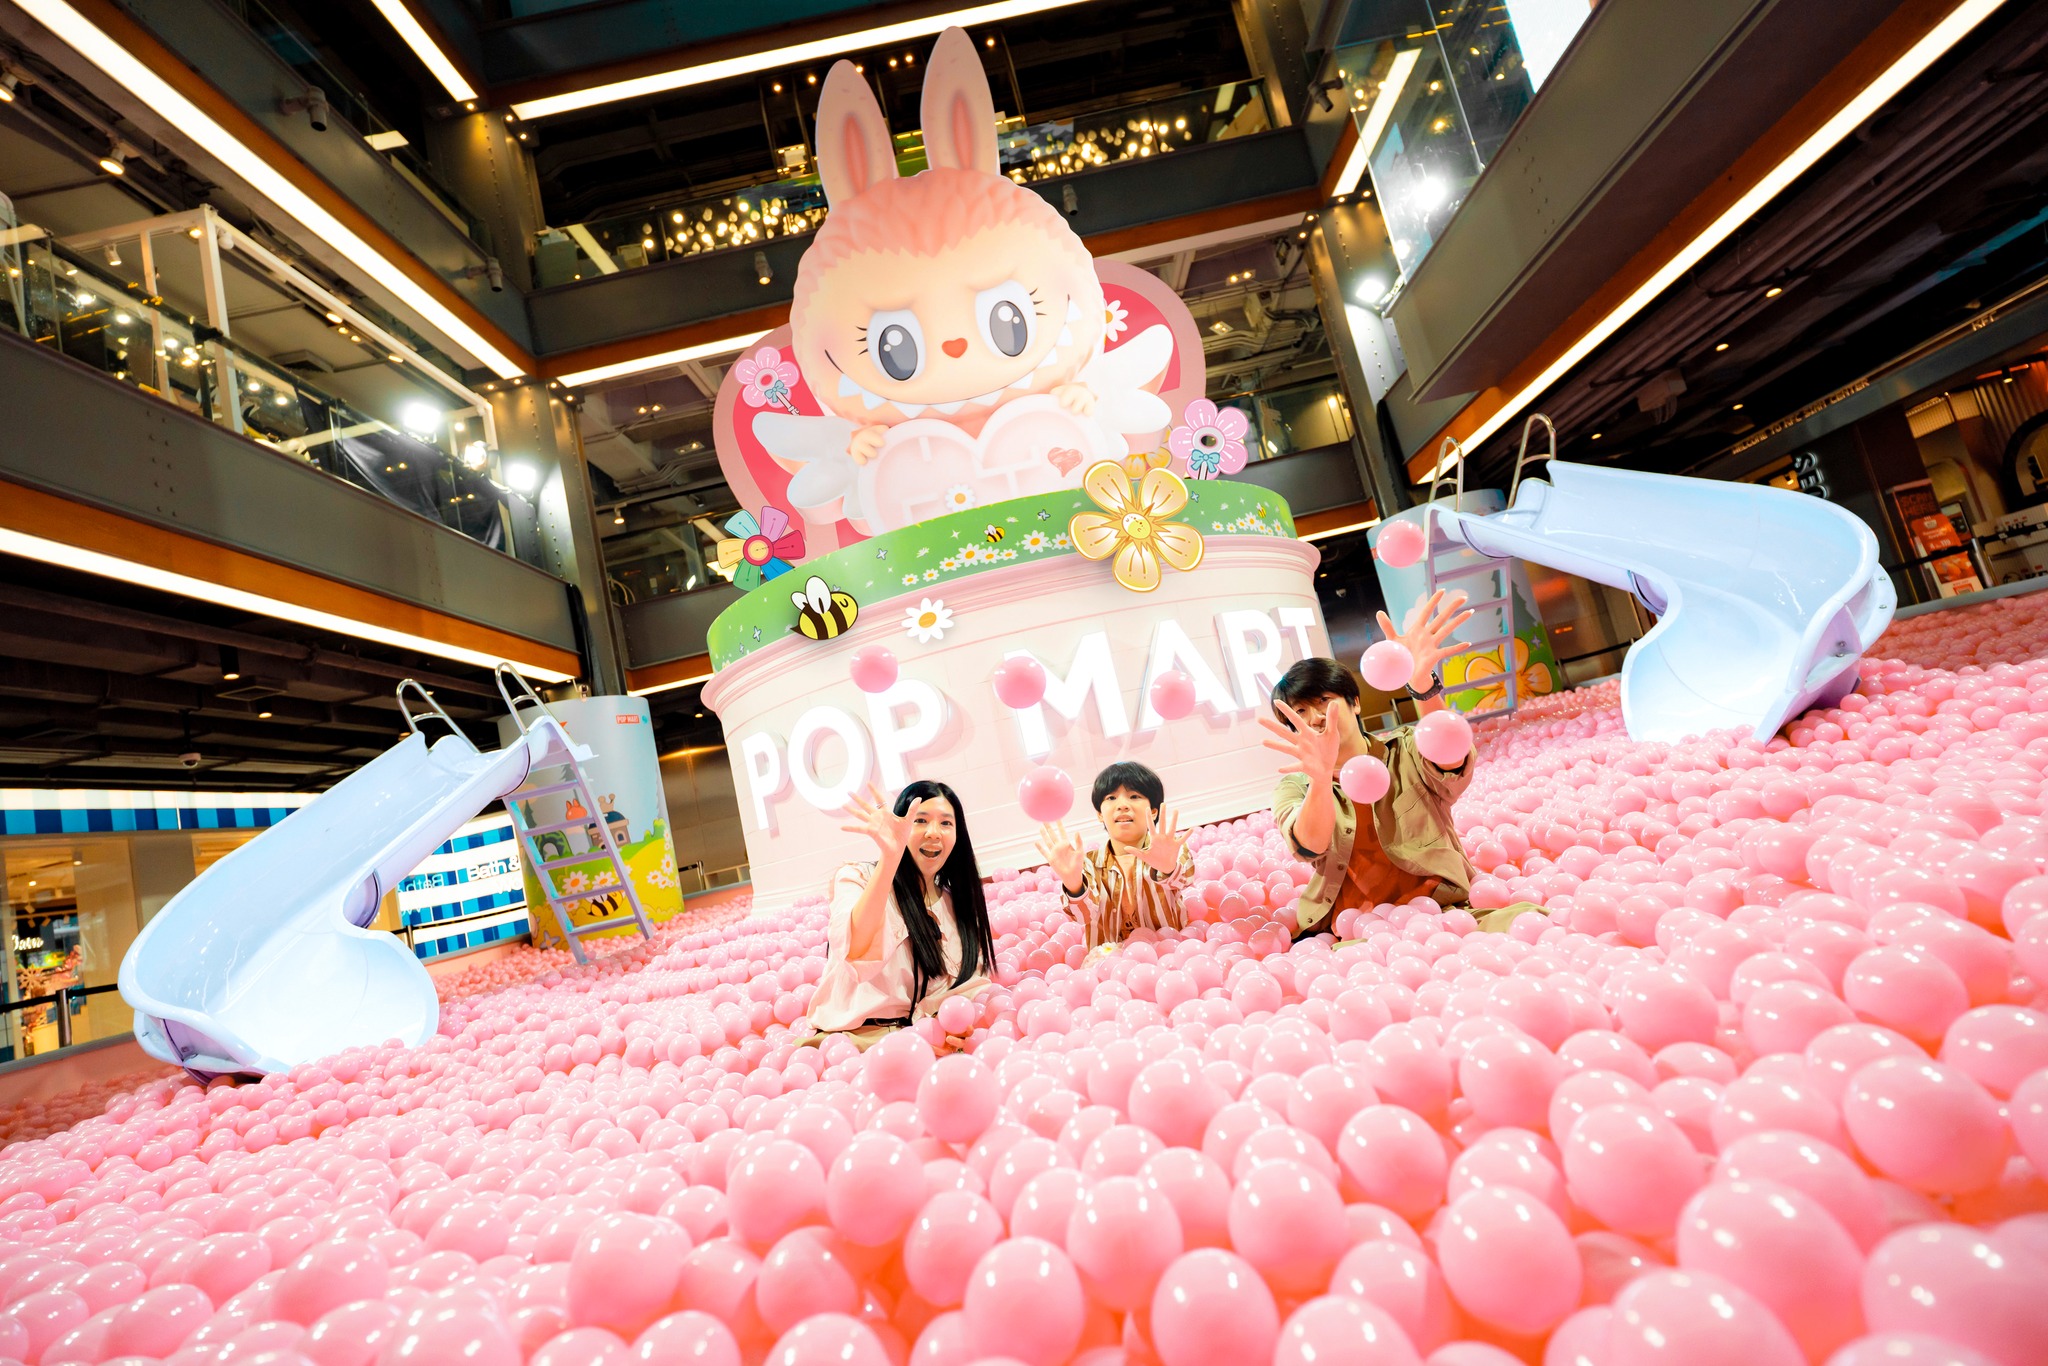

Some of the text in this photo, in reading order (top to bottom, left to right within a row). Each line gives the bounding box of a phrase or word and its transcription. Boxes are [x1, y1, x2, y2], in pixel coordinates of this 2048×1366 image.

[1971, 310, 1997, 331] KFC
[1829, 378, 1870, 405] CENTER
[742, 606, 1317, 830] POP MART
[468, 855, 520, 881] Bath &
